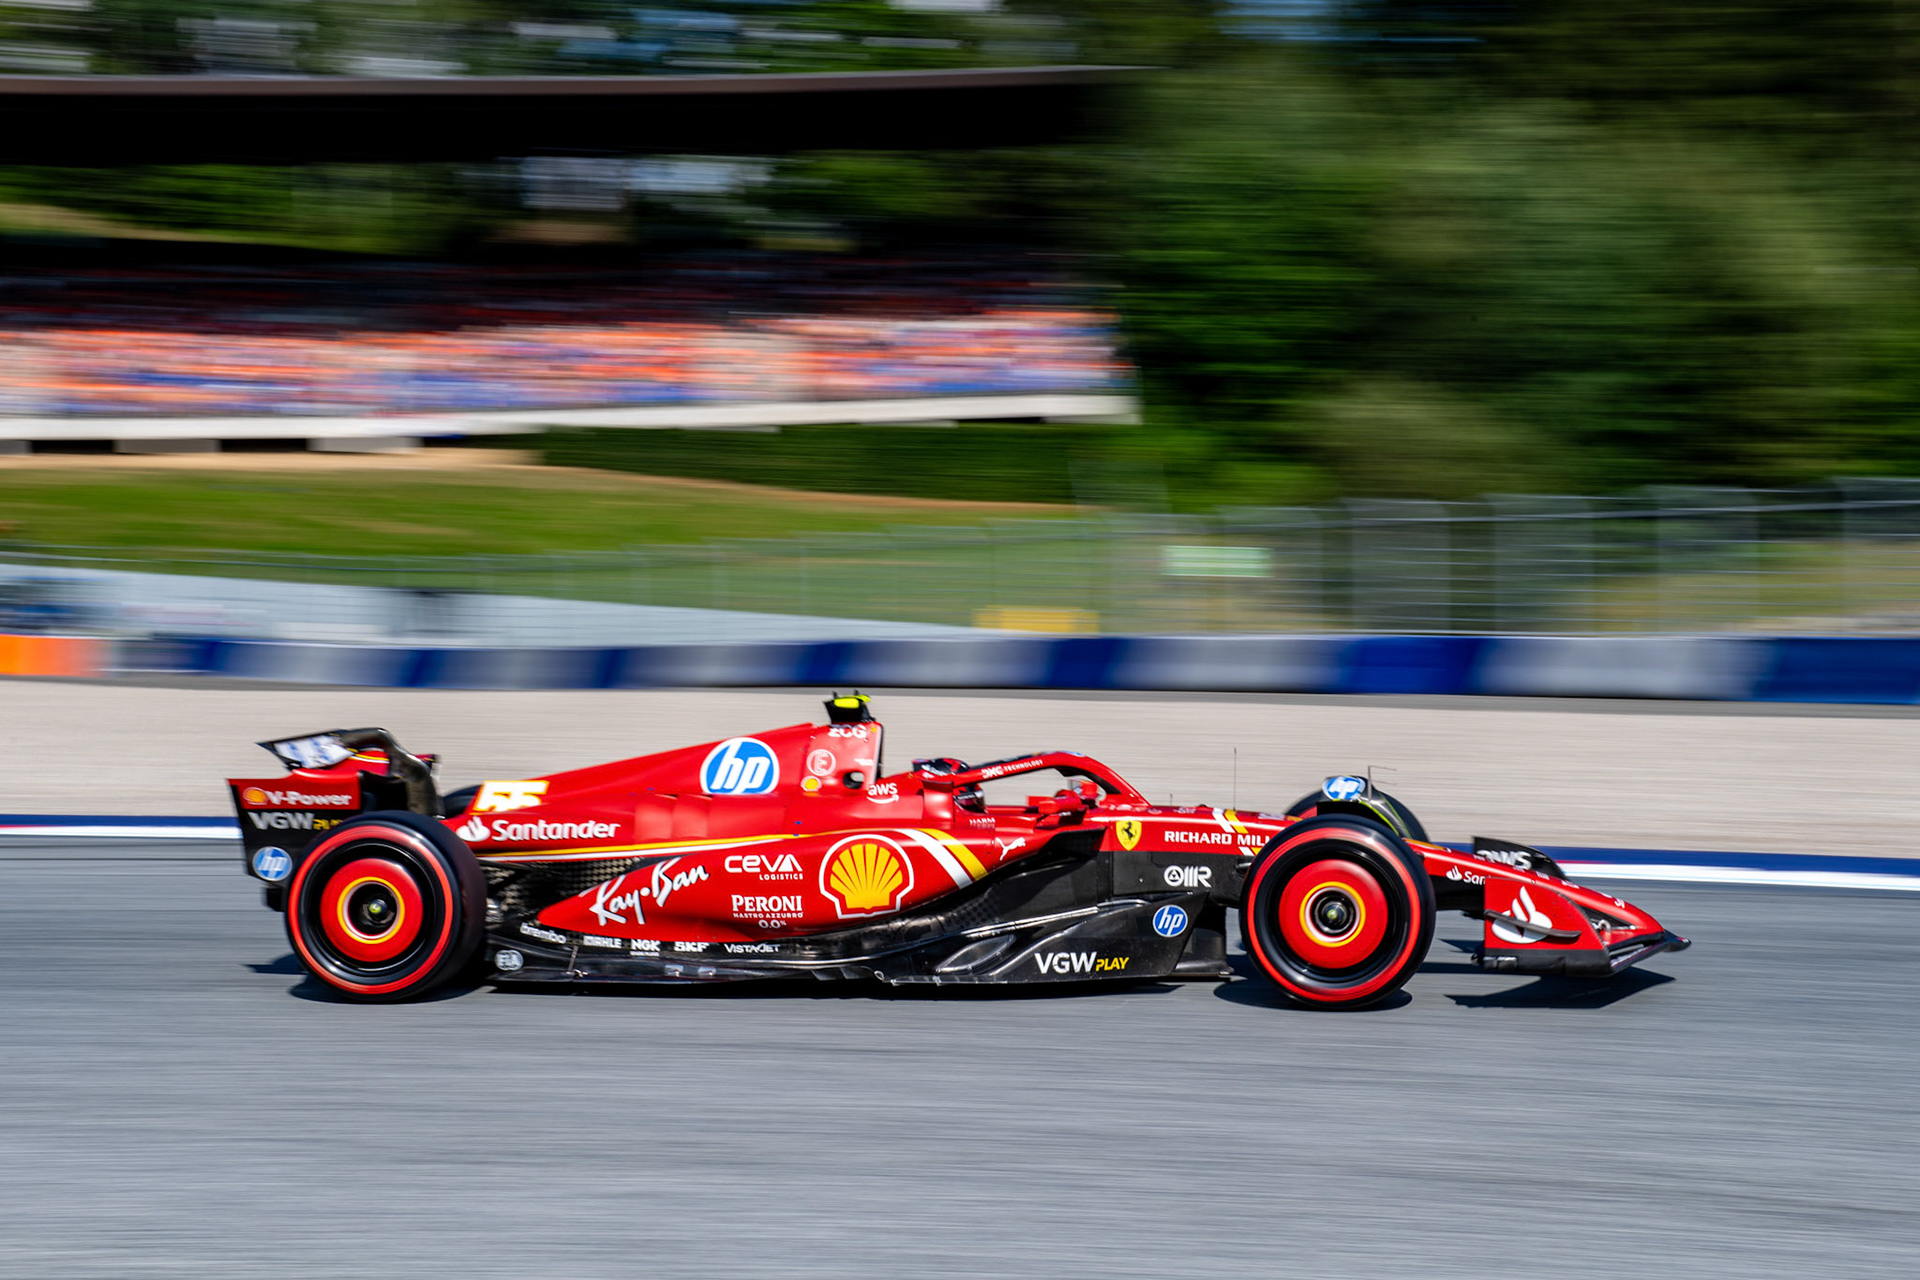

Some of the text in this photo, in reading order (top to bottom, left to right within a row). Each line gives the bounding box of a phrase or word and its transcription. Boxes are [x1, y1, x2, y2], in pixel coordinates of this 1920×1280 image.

[706, 737, 774, 795] hp
[1003, 759, 1044, 772] TECHNOLOGY
[867, 782, 899, 797] aws
[265, 791, 353, 806] V-Power
[247, 812, 315, 831] VGW
[491, 819, 621, 842] Santander
[1164, 831, 1233, 845] RICHARD
[759, 873, 804, 881] LOGISTICS
[731, 894, 803, 912] PERONI
[1156, 904, 1186, 937] hp
[630, 938, 661, 952] NGK
[673, 941, 710, 952] SKF
[1034, 952, 1130, 974] VGW PLAY
